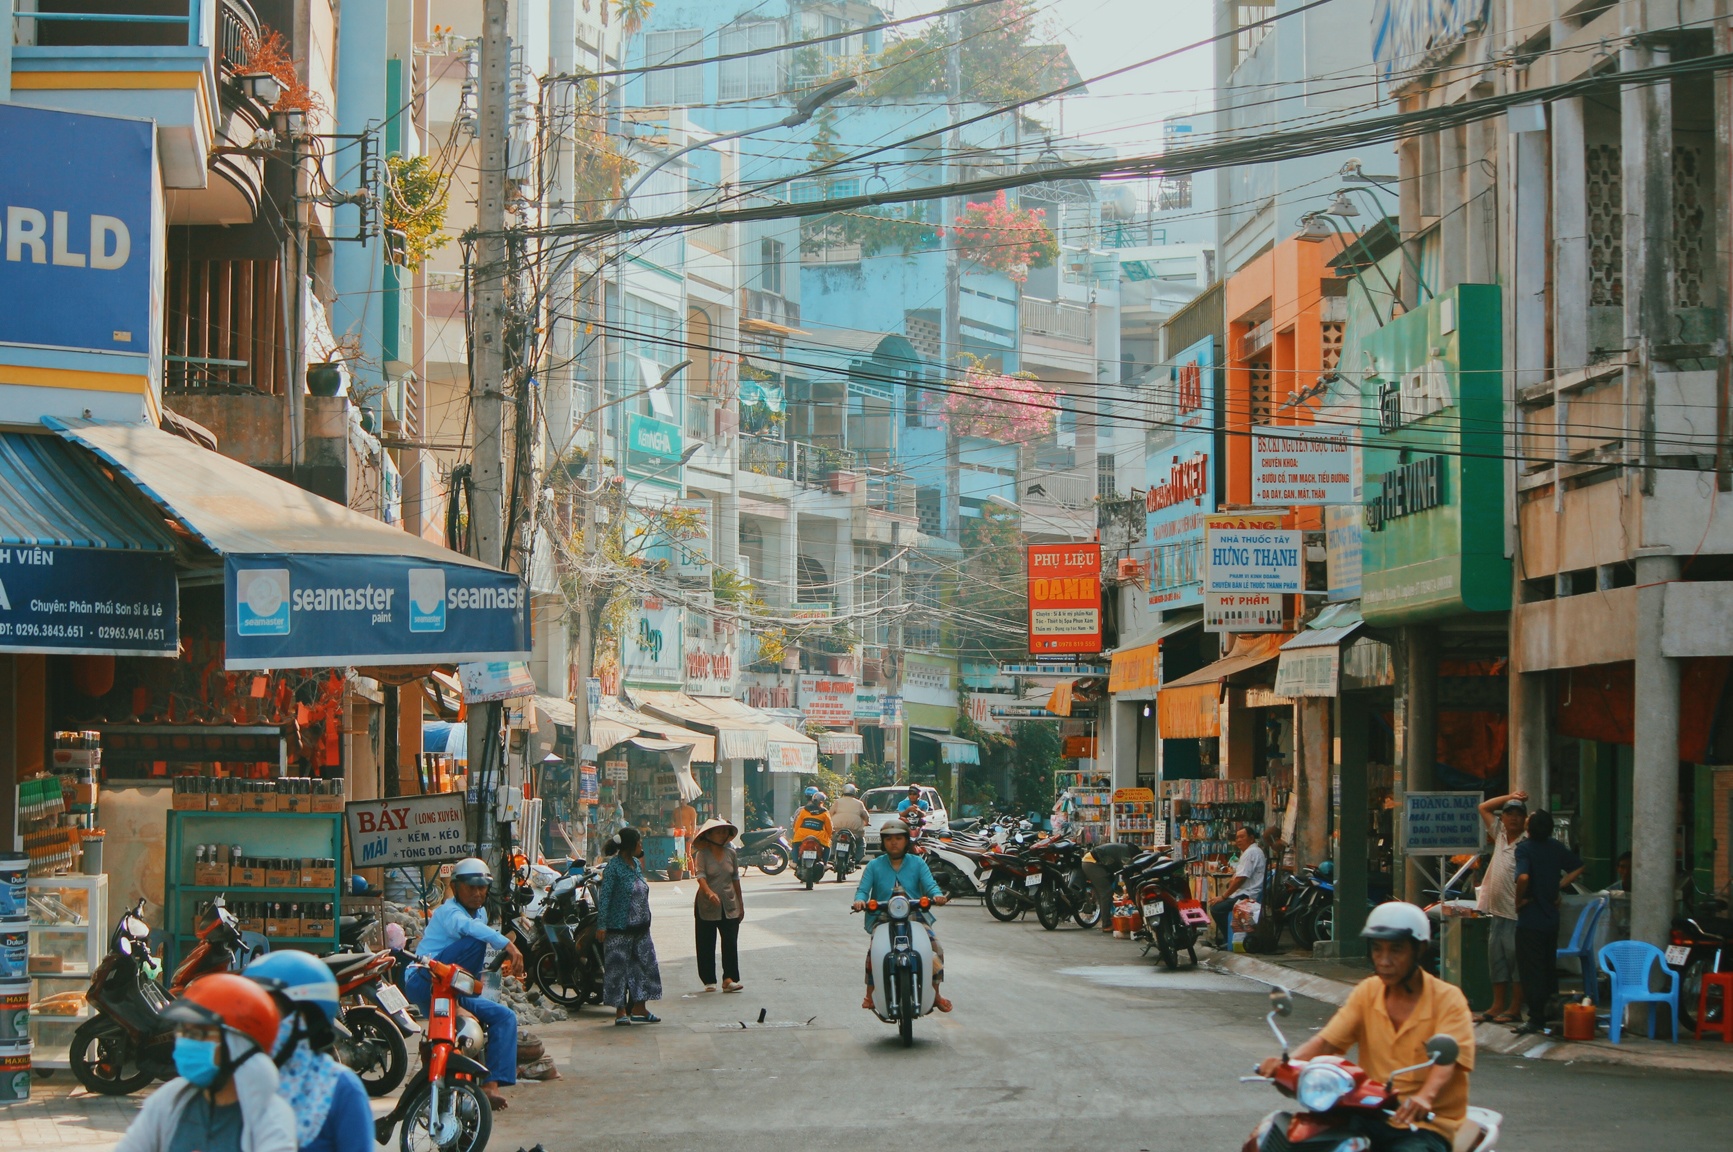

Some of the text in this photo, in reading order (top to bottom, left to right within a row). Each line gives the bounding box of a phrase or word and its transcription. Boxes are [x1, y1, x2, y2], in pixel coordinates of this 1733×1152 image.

[0, 206, 131, 270] RLD
[16, 548, 54, 565] VIÊN
[1034, 550, 1094, 568] PHỤ LIỆU
[1253, 549, 1298, 572] THẠNH
[293, 583, 394, 611] seamaster
[448, 585, 524, 609] seamas
[1034, 578, 1095, 600] OANH
[30, 600, 67, 614] Chuyên:
[70, 600, 92, 613] Phân
[94, 600, 113, 614] Phối
[116, 602, 131, 615] Sơn
[143, 605, 149, 616] &
[152, 603, 162, 616] Lẻ
[244, 617, 284, 627] seamaster
[371, 612, 392, 626] paint
[16, 624, 84, 638] 0296.3843.651
[98, 626, 164, 640] 02963.941.651
[357, 802, 410, 833] BẢY
[440, 828, 459, 840] KÉO
[362, 836, 388, 861] MÀI
